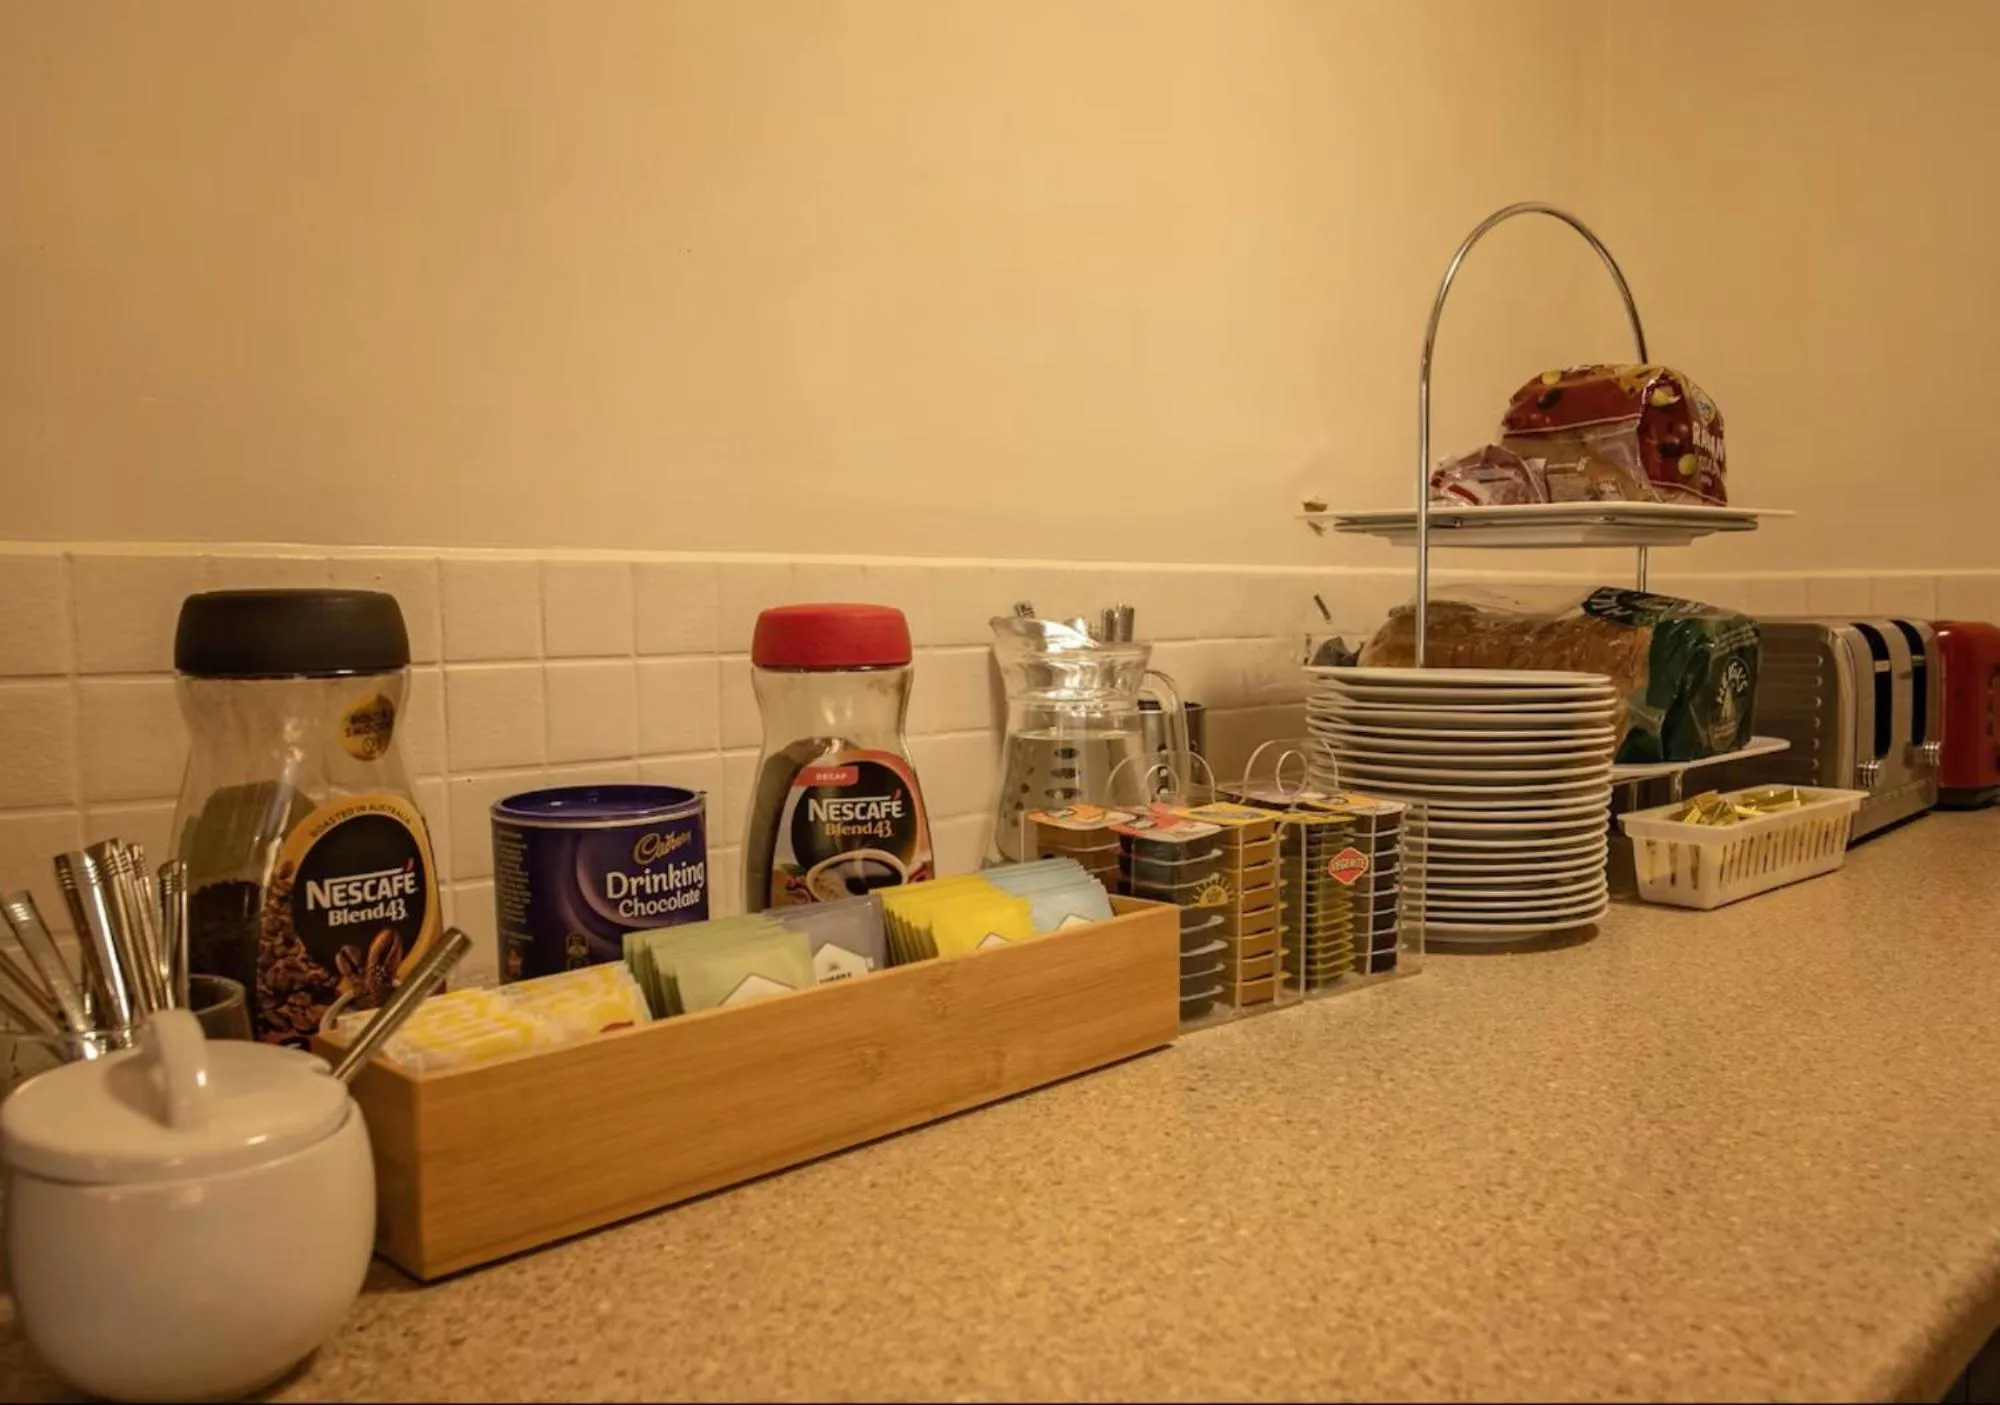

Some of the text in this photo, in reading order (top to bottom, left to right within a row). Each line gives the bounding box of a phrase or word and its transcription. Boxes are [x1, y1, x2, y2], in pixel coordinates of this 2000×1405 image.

[808, 788, 902, 822] NESCAFÉ
[306, 857, 416, 911] NESCAFÉ
[606, 861, 704, 899] Drinking
[619, 889, 701, 918] Chocolate
